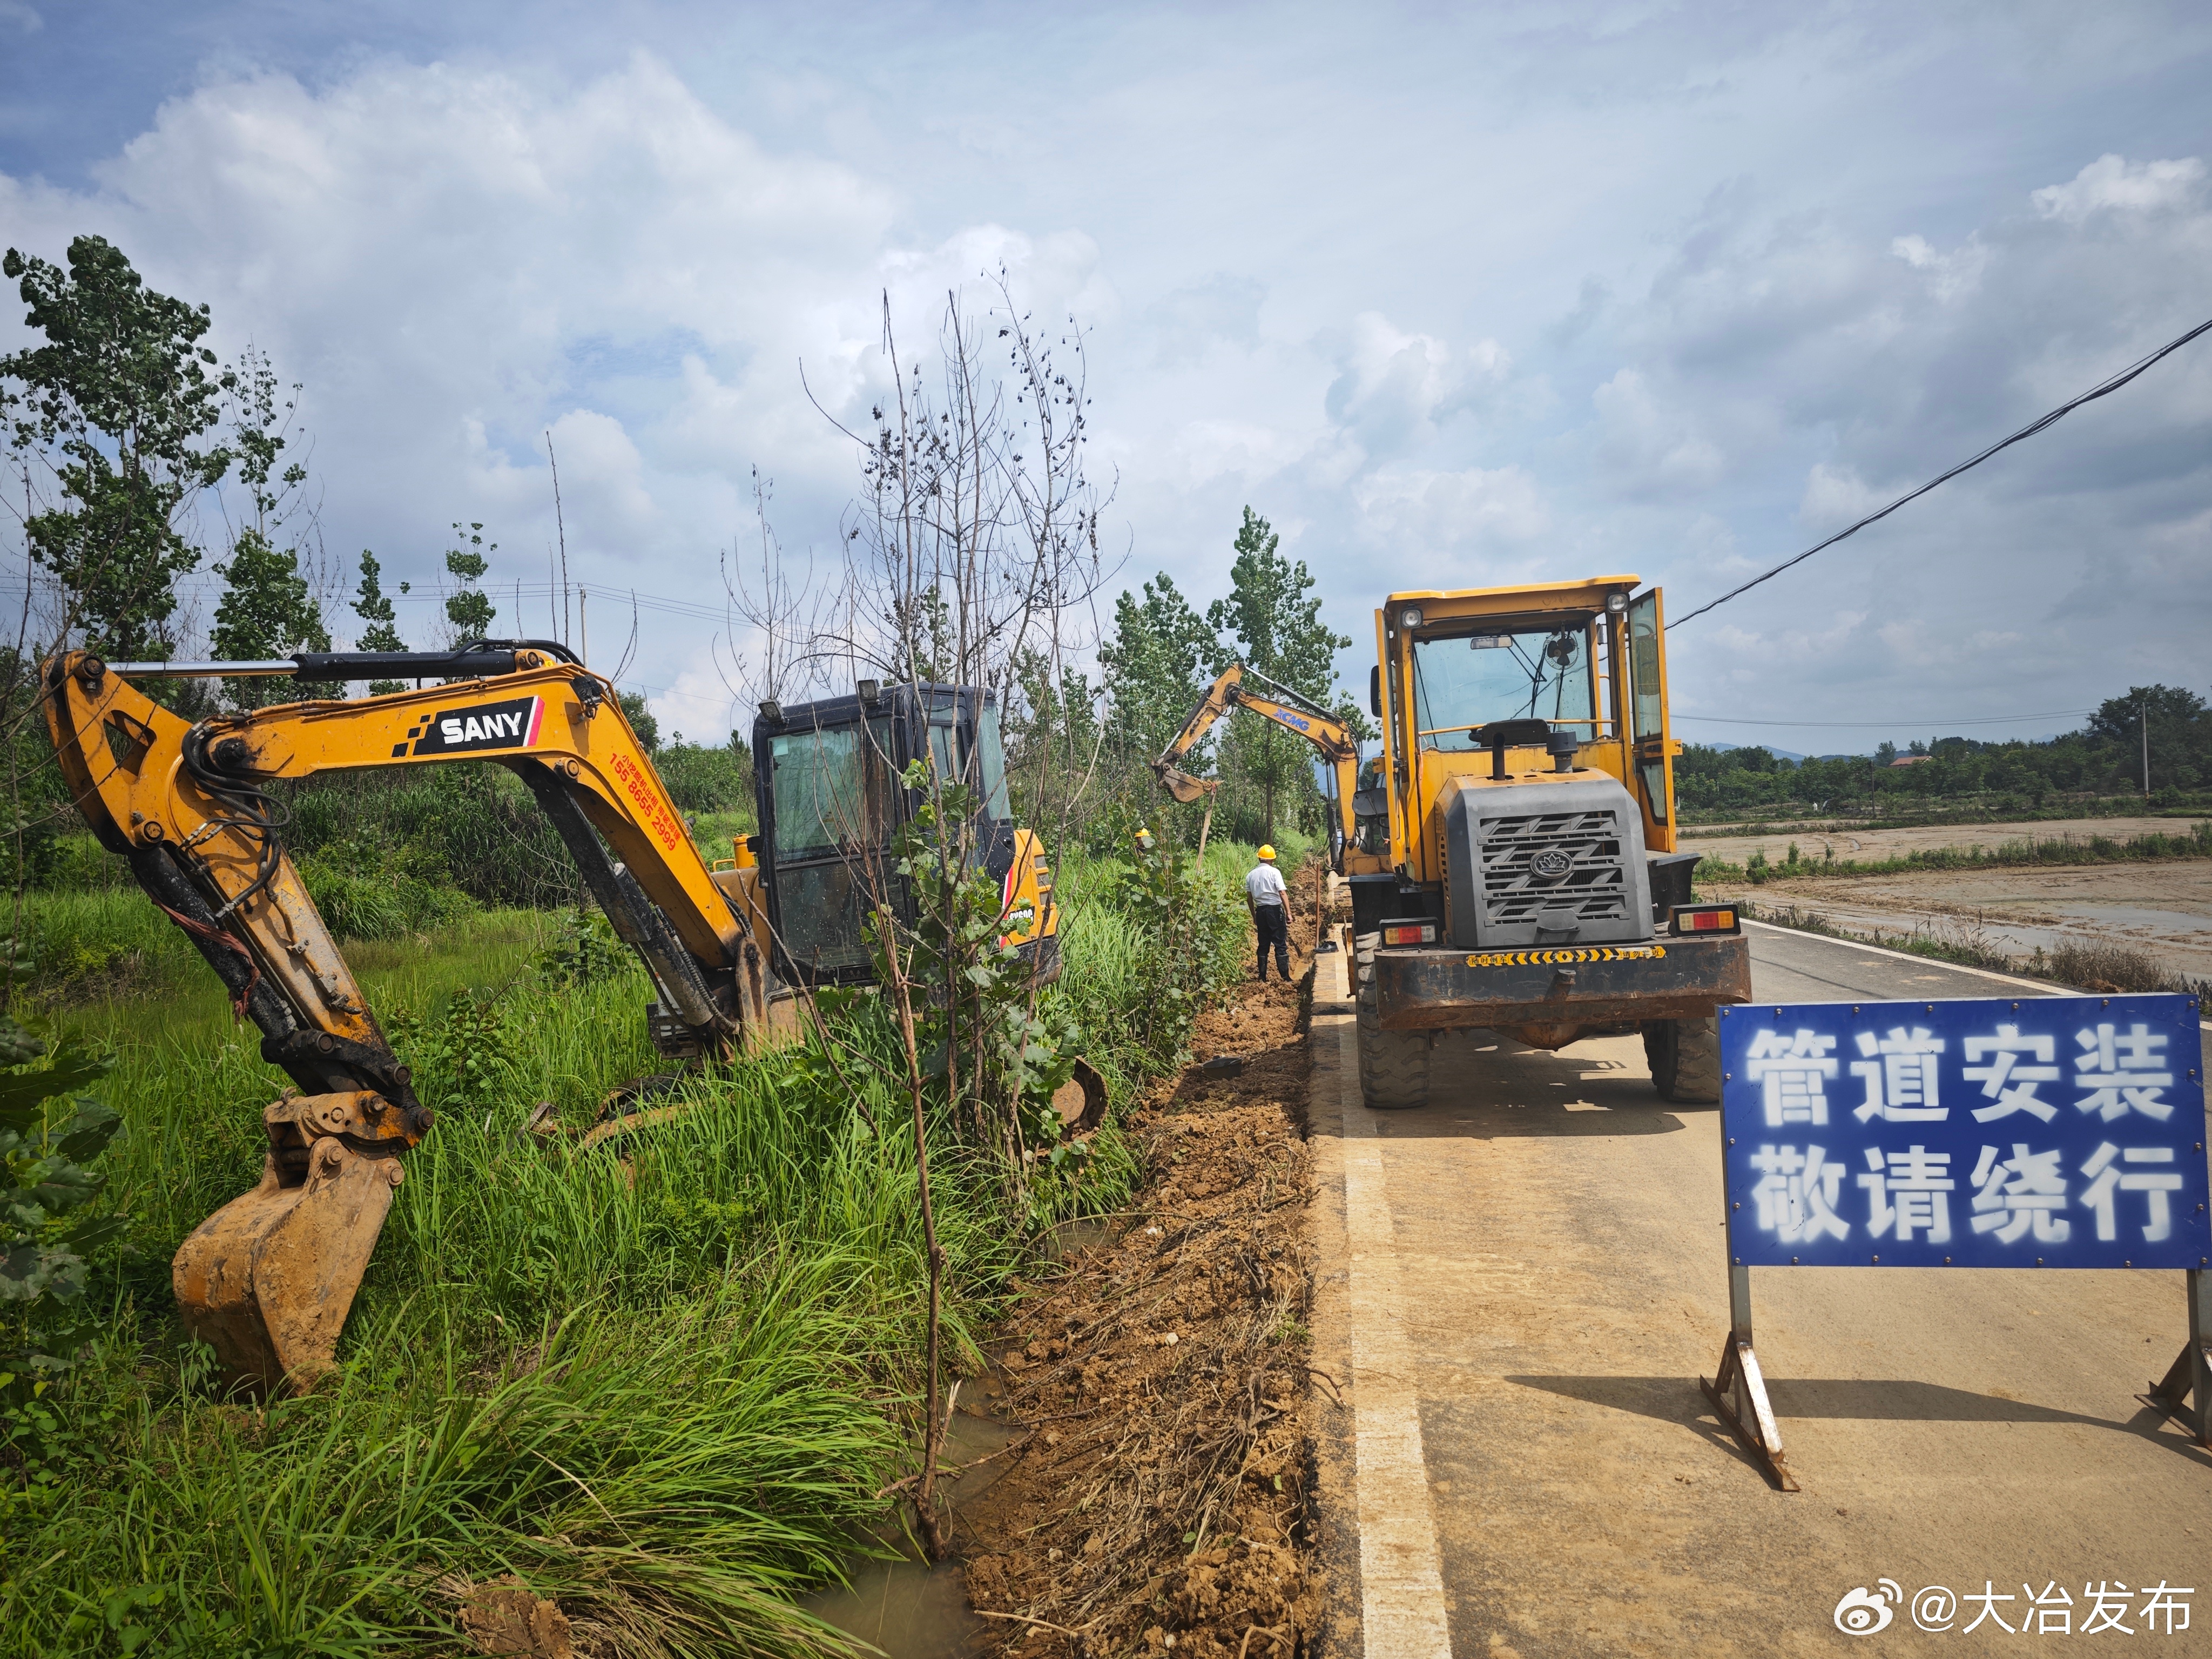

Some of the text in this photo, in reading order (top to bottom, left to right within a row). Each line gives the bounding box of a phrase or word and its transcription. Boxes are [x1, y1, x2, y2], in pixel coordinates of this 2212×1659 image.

[440, 712, 522, 744] SANY
[1272, 707, 1310, 731] XCMG
[610, 753, 676, 851] 155 8655 2999
[622, 754, 659, 808] 小挖掘机出租
[1745, 1022, 2175, 1128] 管道安装
[1750, 1141, 2183, 1244] 敬请绕行
